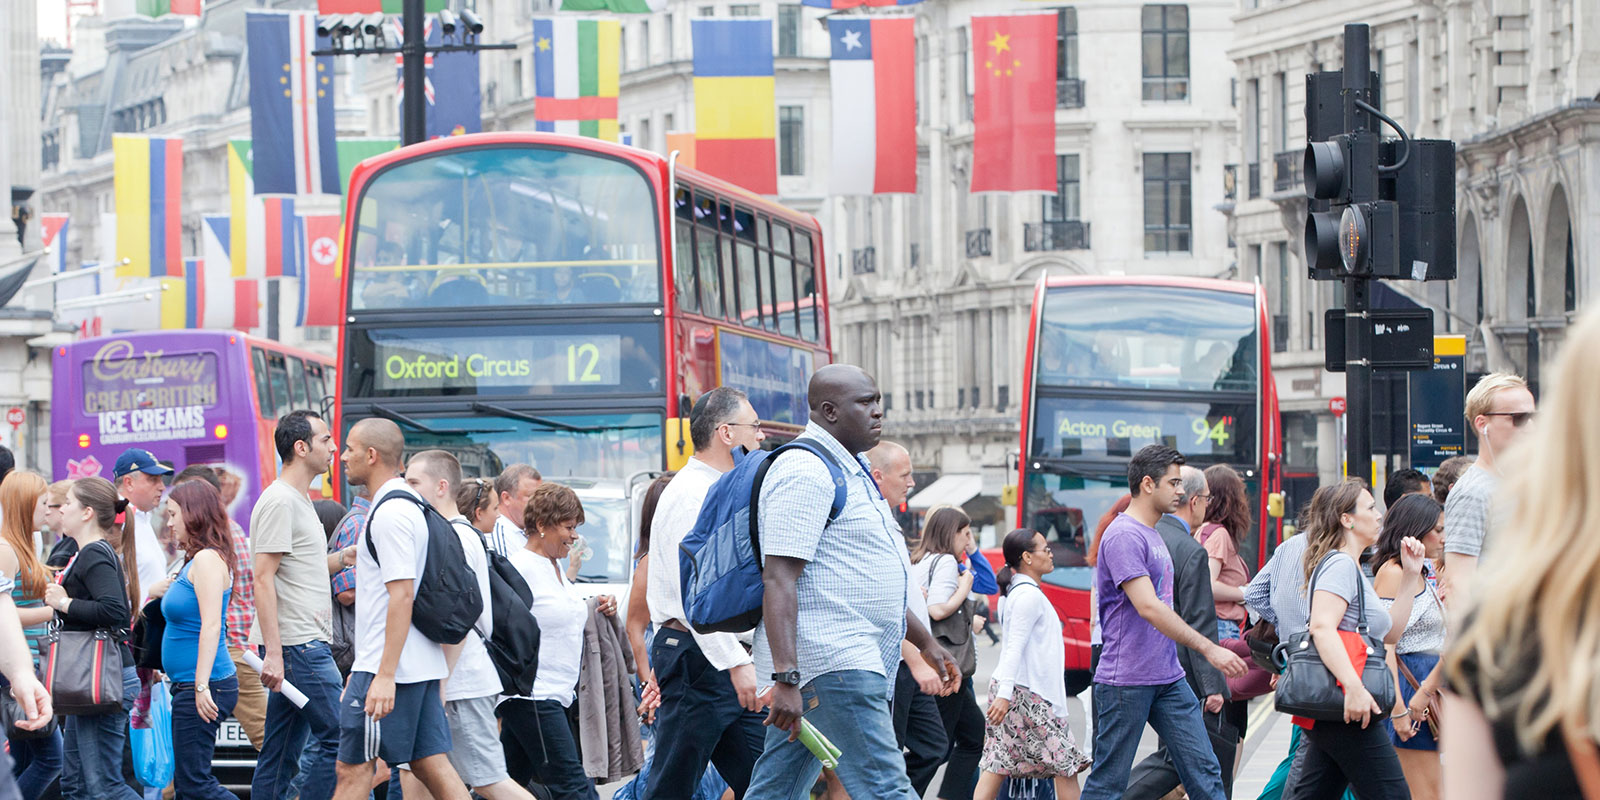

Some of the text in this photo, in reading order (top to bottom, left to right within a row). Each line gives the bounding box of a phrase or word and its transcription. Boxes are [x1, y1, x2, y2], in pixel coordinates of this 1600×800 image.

[92, 340, 206, 382] Cadbury
[386, 343, 601, 382] Oxford Circus 12
[85, 383, 217, 413] GREAT BRITISH
[98, 405, 205, 434] ICE CREAMS
[1058, 418, 1106, 437] Acton
[1112, 420, 1161, 438] Green
